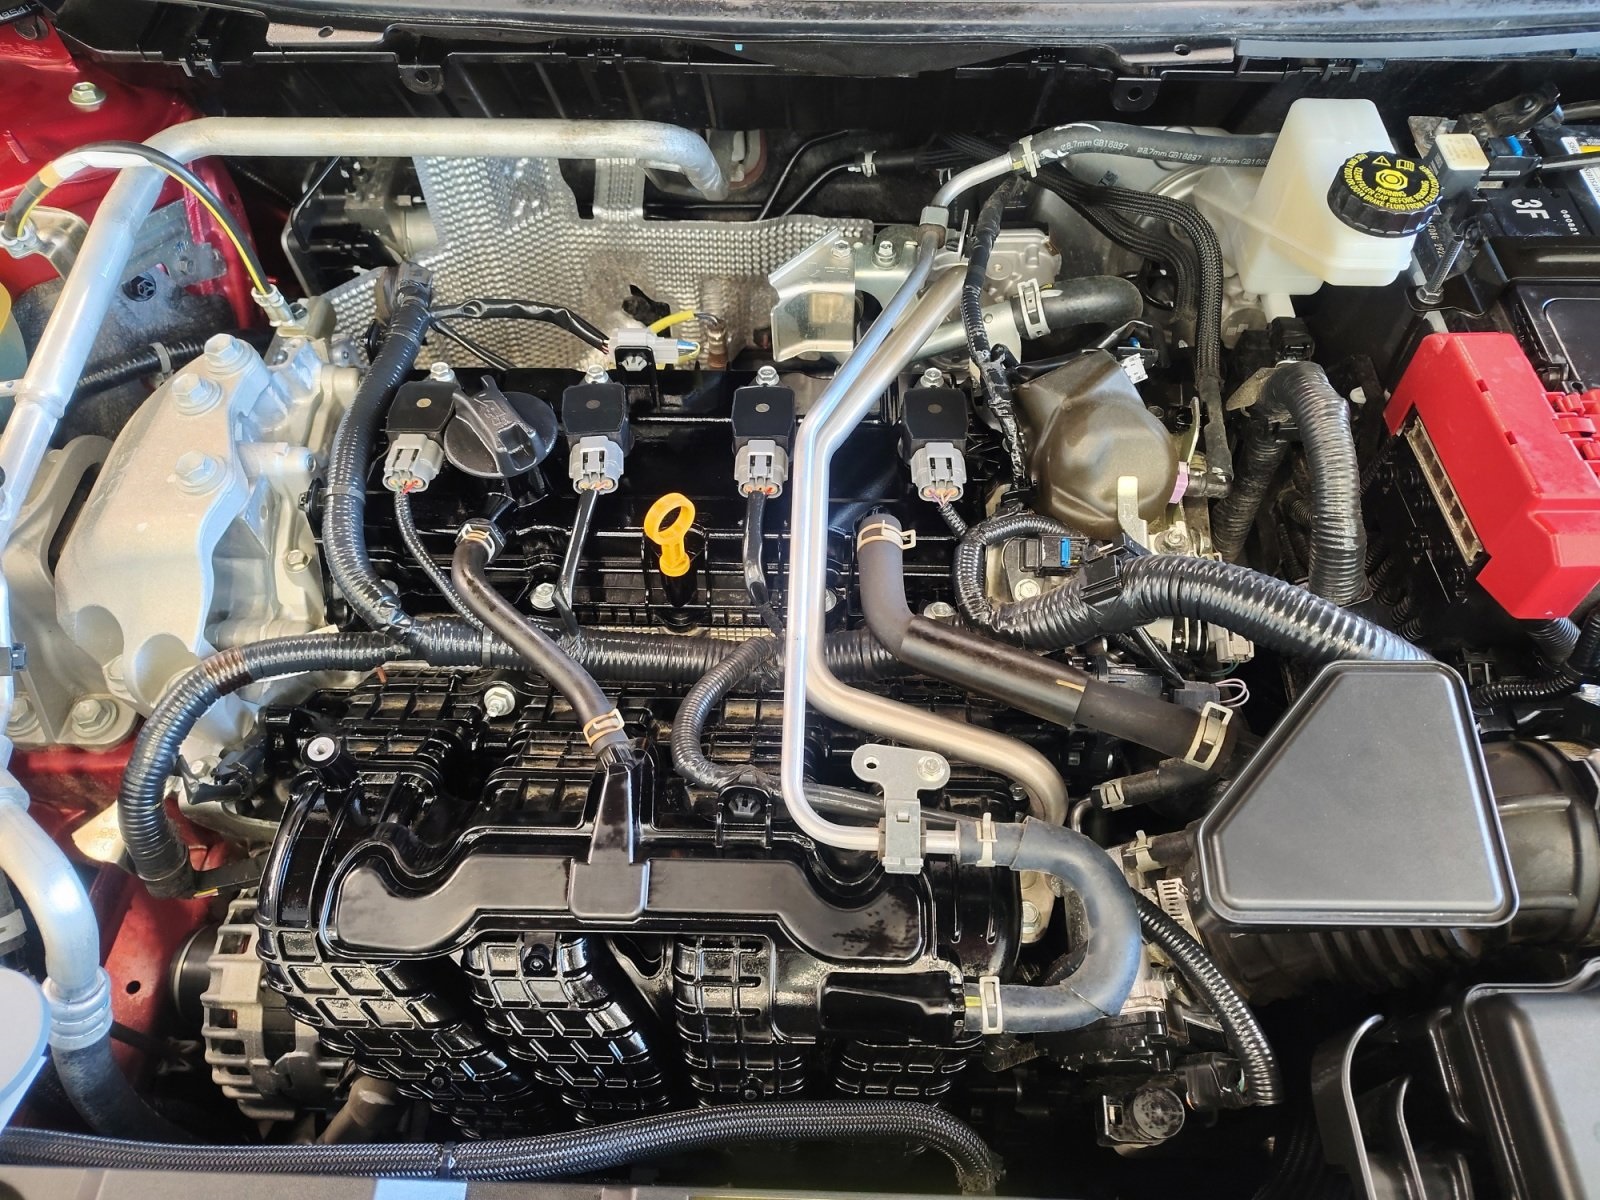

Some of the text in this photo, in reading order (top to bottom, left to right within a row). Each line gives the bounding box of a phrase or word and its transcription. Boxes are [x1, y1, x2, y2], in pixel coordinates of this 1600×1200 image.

[1363, 194, 1385, 207] BRAKE
[1386, 202, 1406, 211] FLUID
[1406, 201, 1425, 210] FROM
[1374, 192, 1389, 201] CAP
[1511, 199, 1550, 219] 3F
